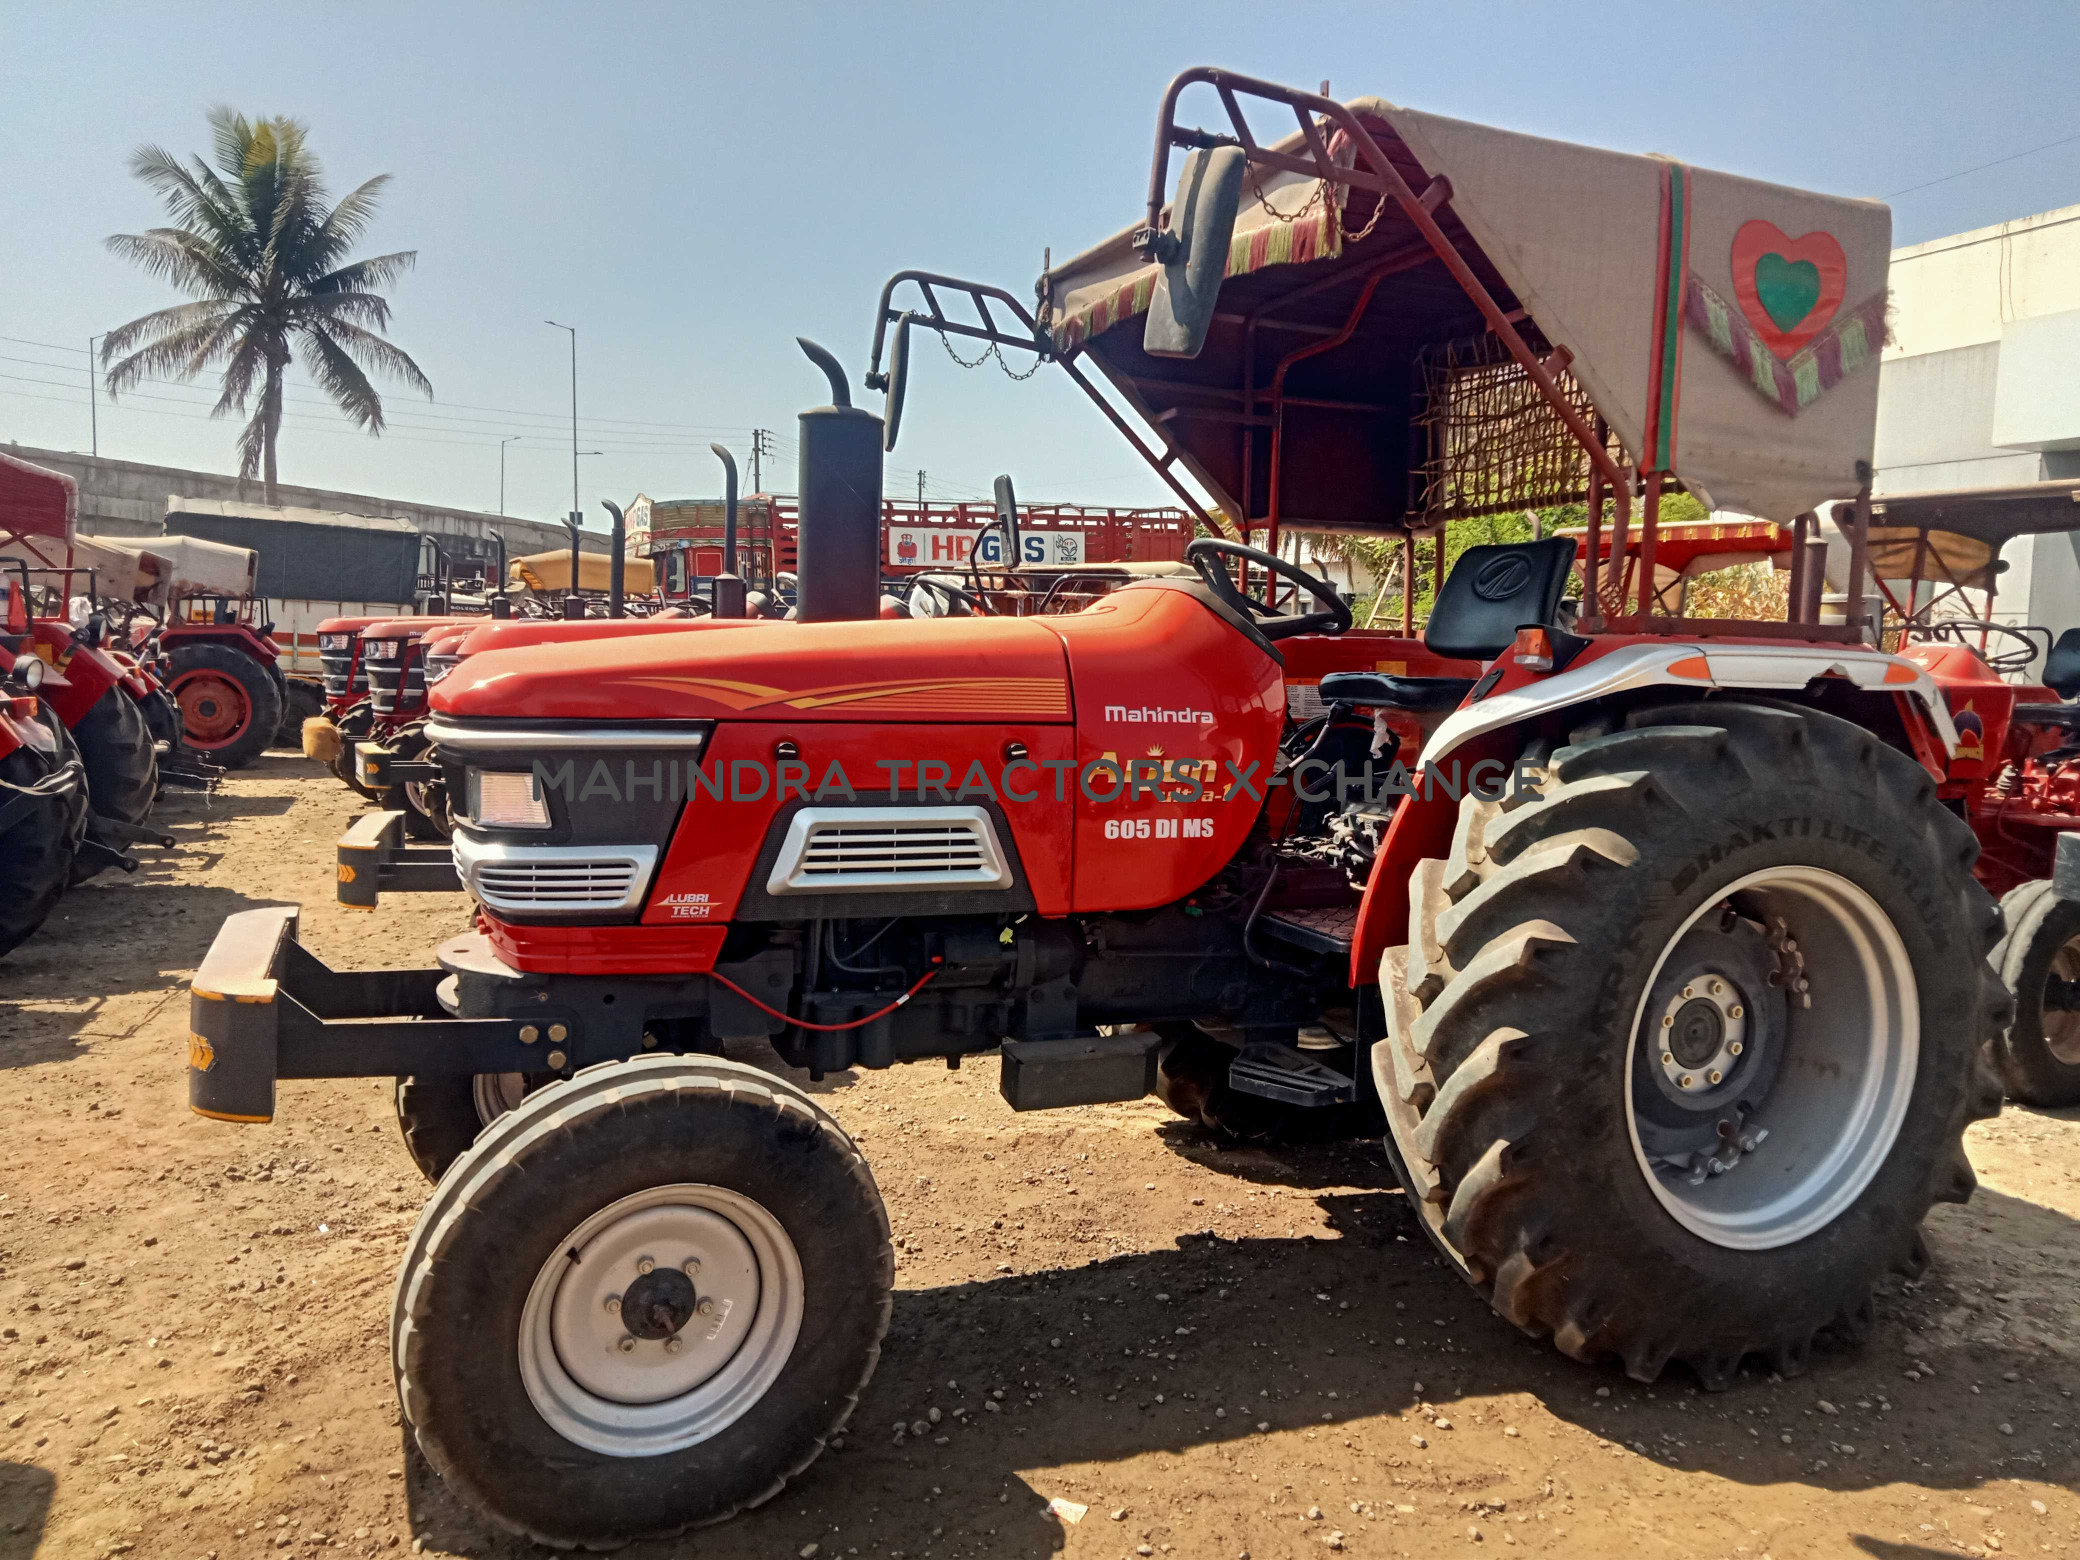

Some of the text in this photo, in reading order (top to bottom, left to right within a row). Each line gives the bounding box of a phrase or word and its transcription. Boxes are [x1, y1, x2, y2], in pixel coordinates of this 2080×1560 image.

[931, 534, 1045, 562] HP GS
[1104, 705, 1214, 724] Mahindra
[1104, 818, 1214, 839] 605 DI MS
[669, 893, 710, 903] LUBRI
[672, 906, 710, 915] TECH
